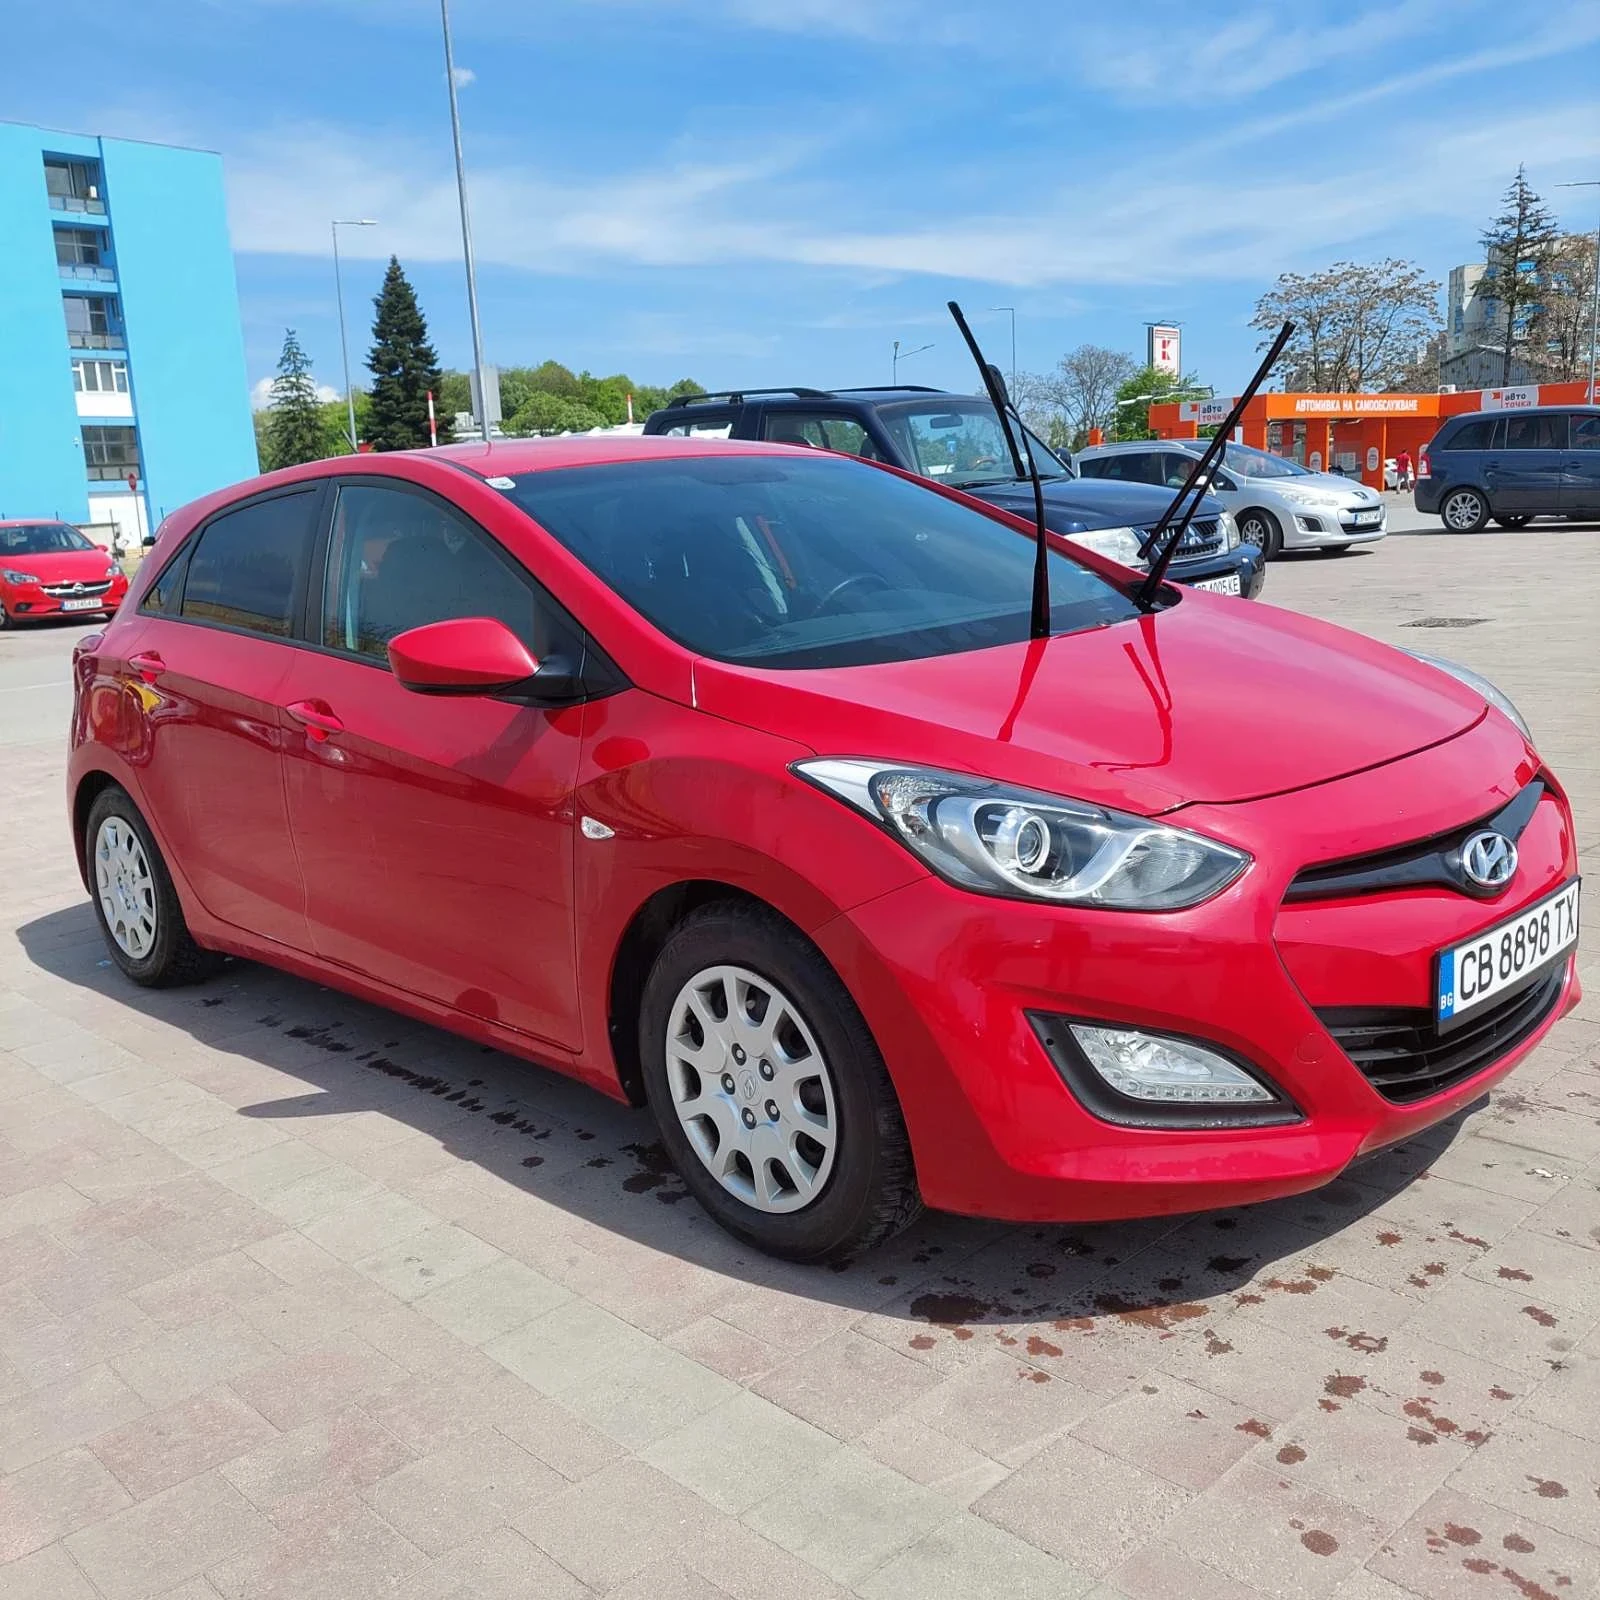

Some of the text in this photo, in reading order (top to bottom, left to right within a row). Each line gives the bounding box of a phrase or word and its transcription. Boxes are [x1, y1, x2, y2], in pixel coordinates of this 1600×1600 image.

[1161, 339, 1171, 361] K
[1295, 399, 1418, 412] АВТОМИВКА НА САМООБСЛУЖВАНЕ
[1228, 577, 1239, 593] KE
[1460, 889, 1576, 1001] CB 8898 TX
[1440, 992, 1453, 1010] BG
